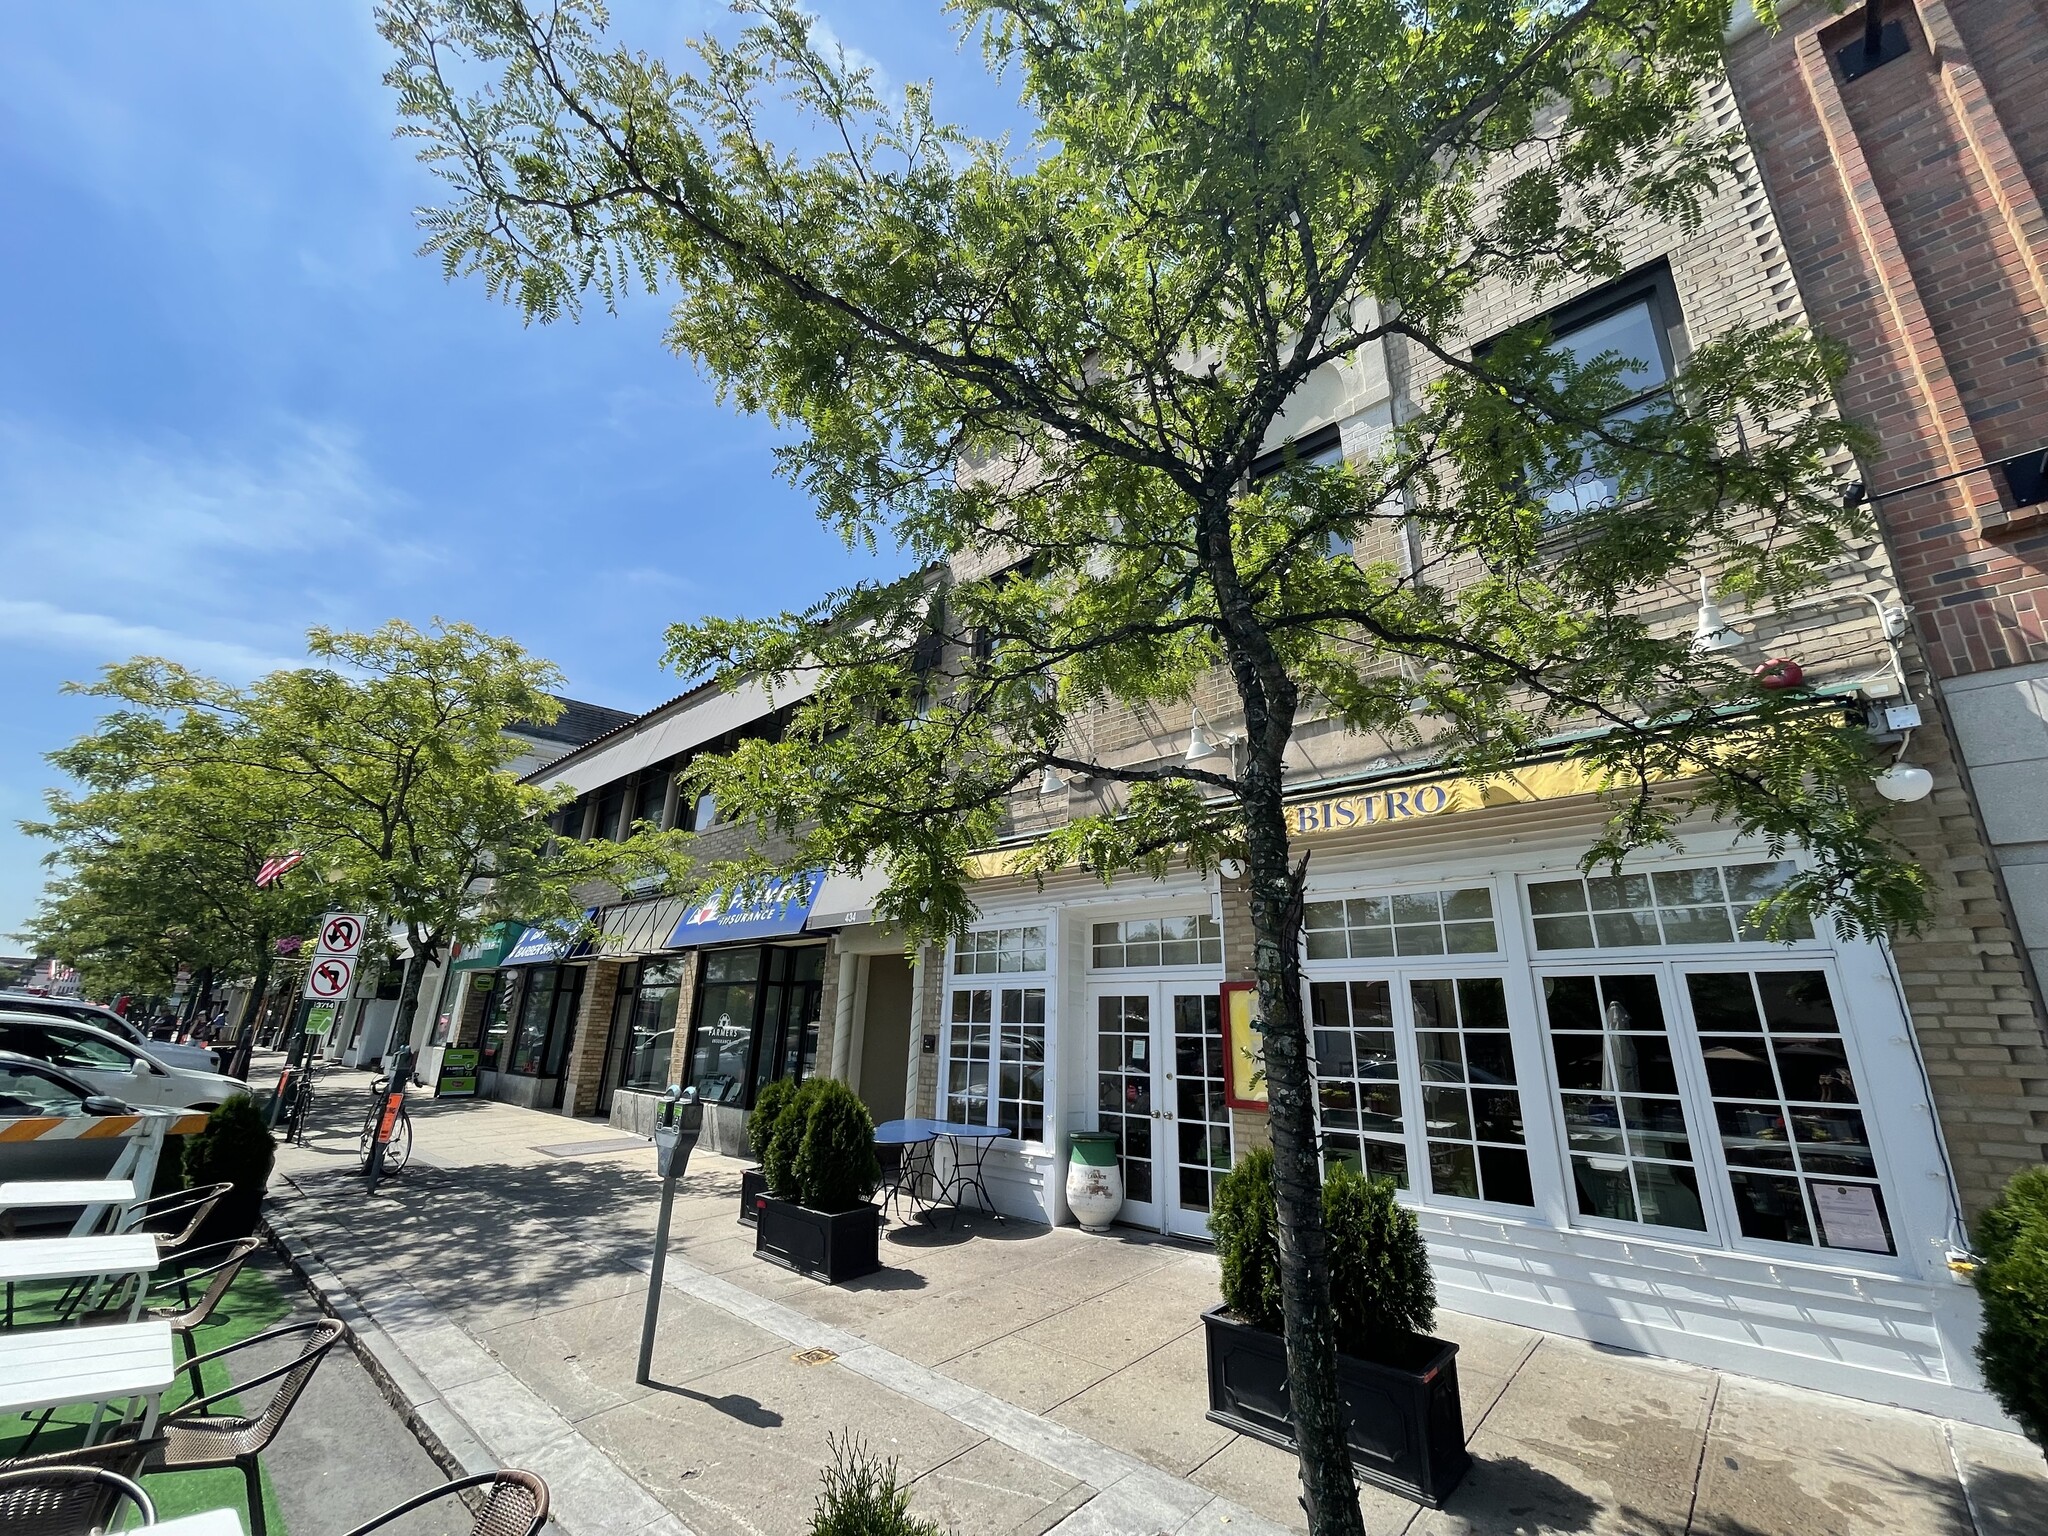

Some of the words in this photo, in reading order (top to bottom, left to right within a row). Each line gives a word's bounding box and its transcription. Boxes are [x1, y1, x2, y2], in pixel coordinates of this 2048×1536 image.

[1299, 785, 1446, 832] BISTRO
[718, 909, 776, 926] INSURANCE
[844, 912, 857, 922] 434
[514, 943, 544, 958] BARBER
[708, 1028, 738, 1037] FARMERS
